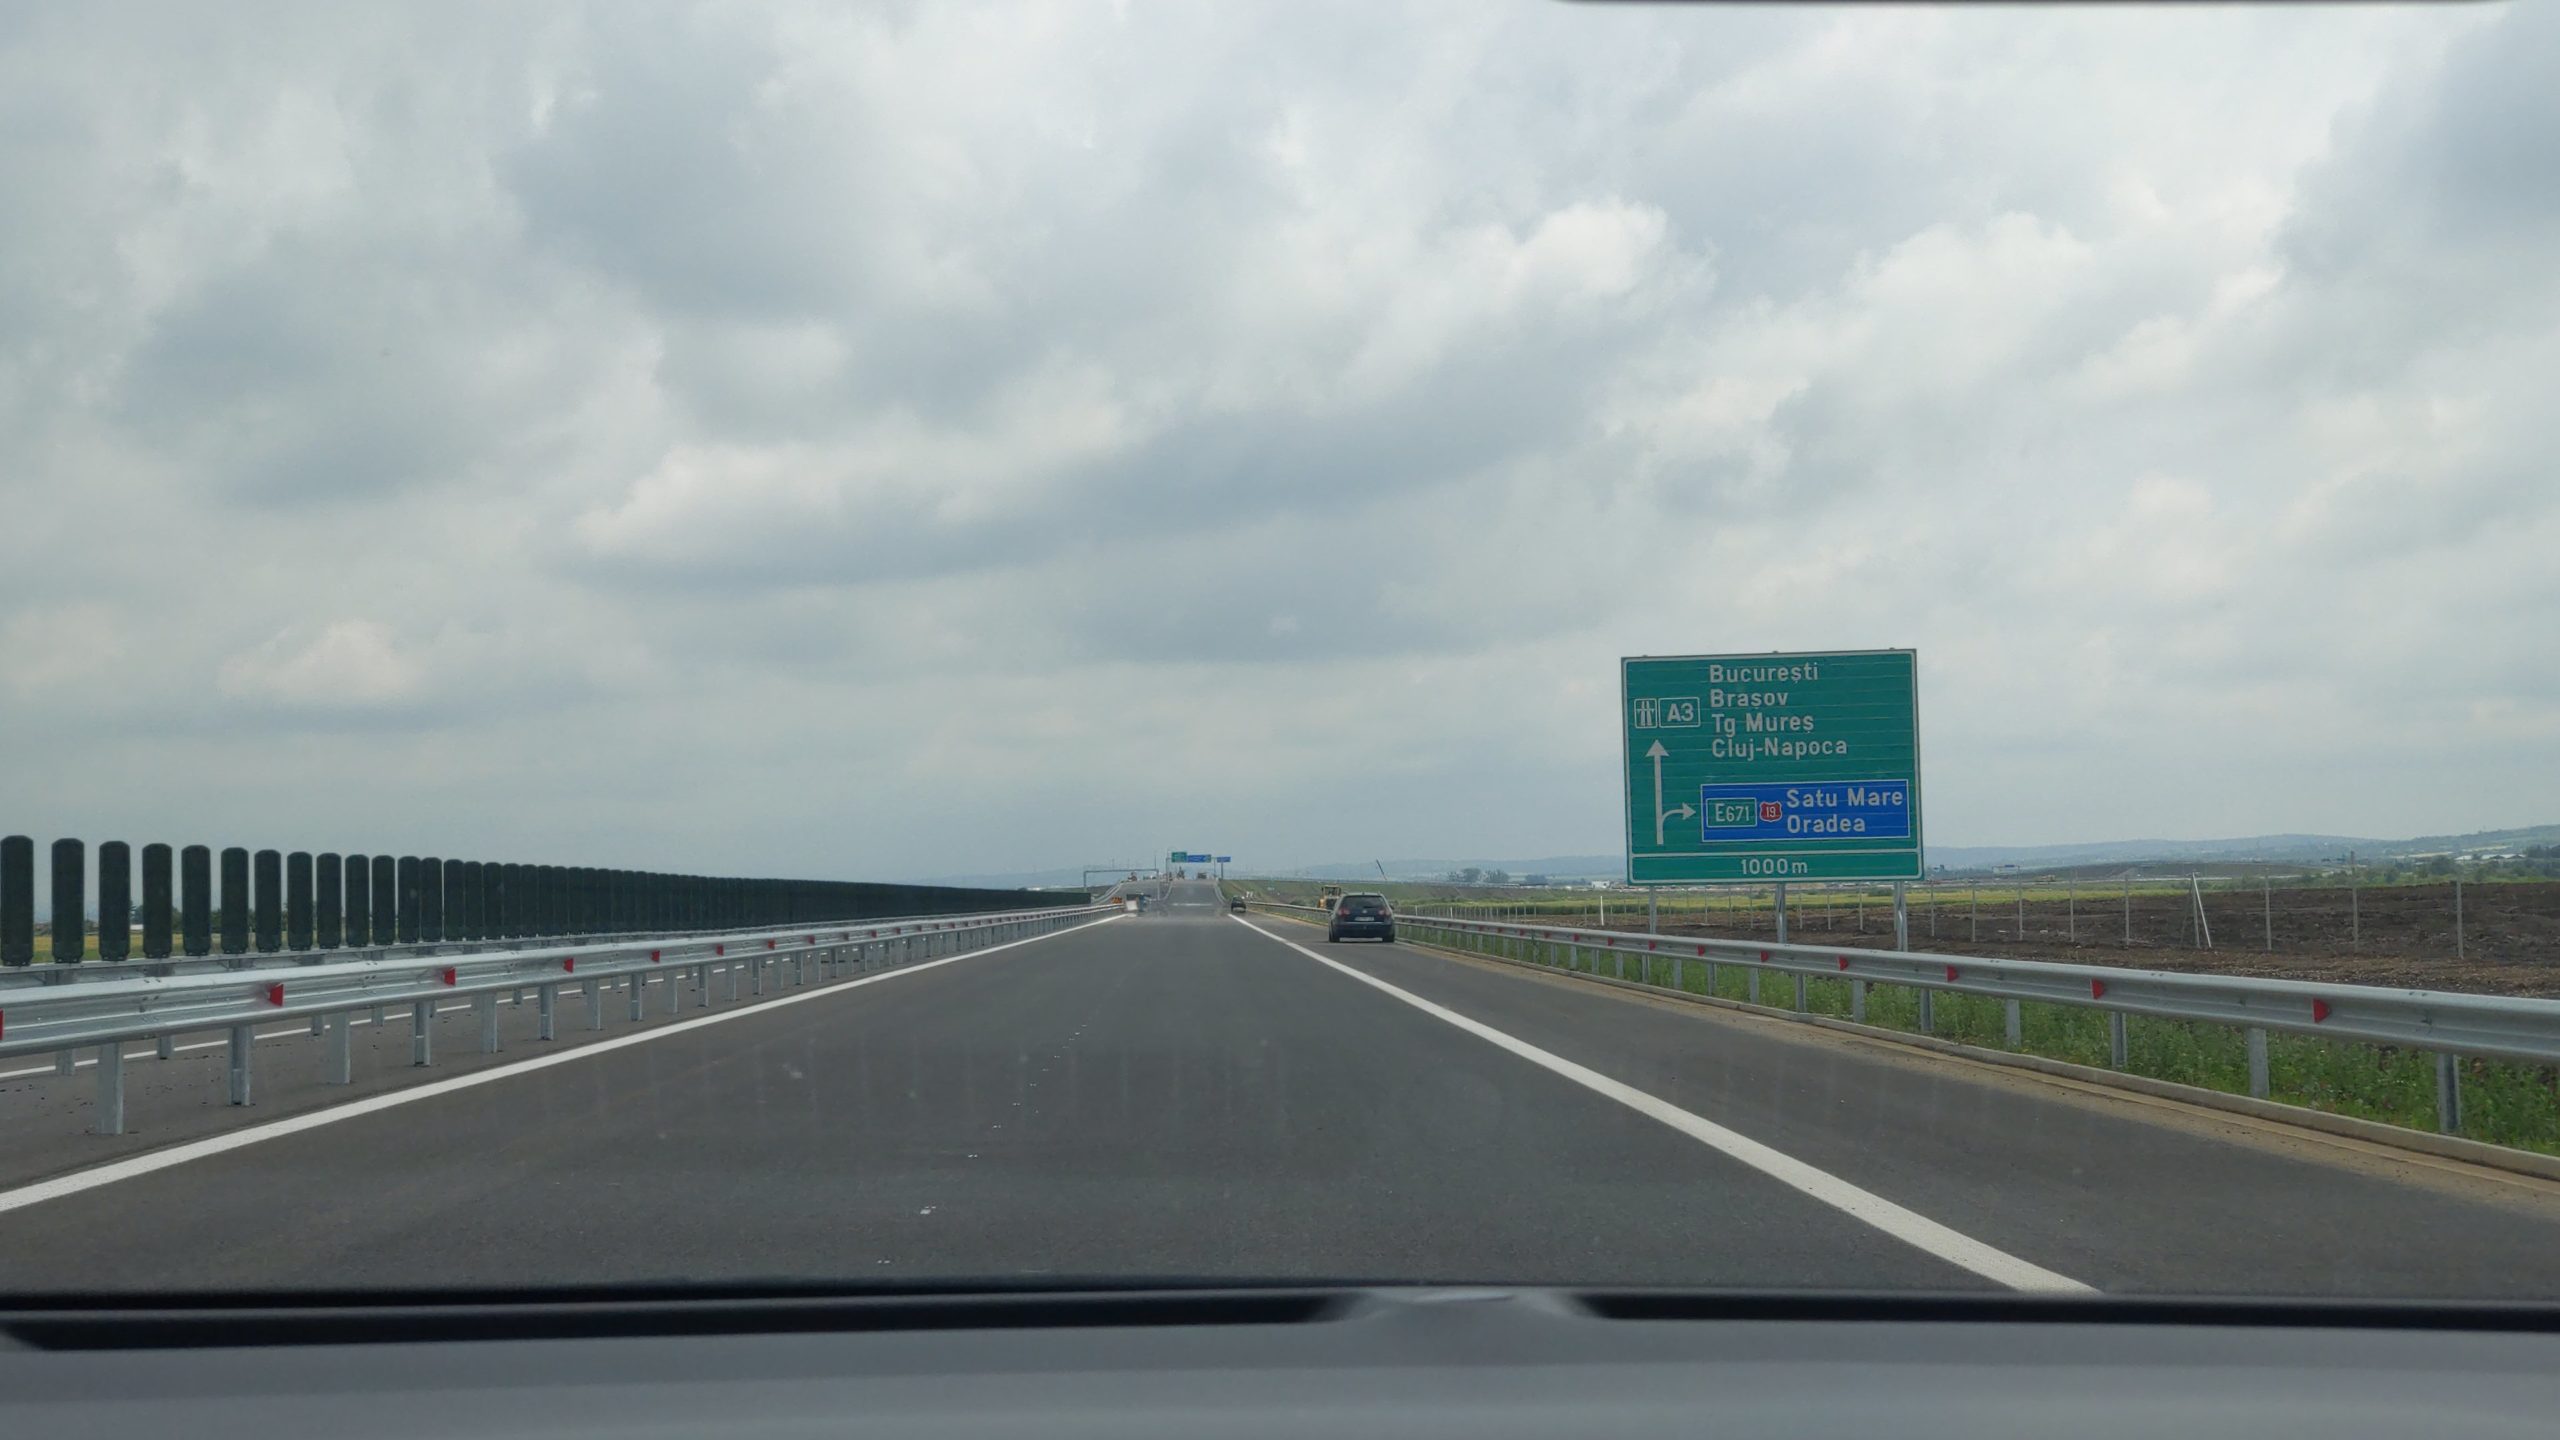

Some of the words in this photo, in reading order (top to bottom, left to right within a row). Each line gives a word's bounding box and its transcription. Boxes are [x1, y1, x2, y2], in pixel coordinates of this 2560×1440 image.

[1709, 662, 1818, 684] București
[1710, 689, 1788, 709] Brașov
[1667, 703, 1694, 722] A3
[1712, 714, 1735, 737] Tg
[1746, 714, 1814, 734] Mureș
[1712, 737, 1847, 761] Cluj-Napoca
[1786, 789, 1837, 808] Satu
[1848, 787, 1903, 806] Mare
[1715, 803, 1750, 822] E671
[1787, 814, 1866, 833] Oradea
